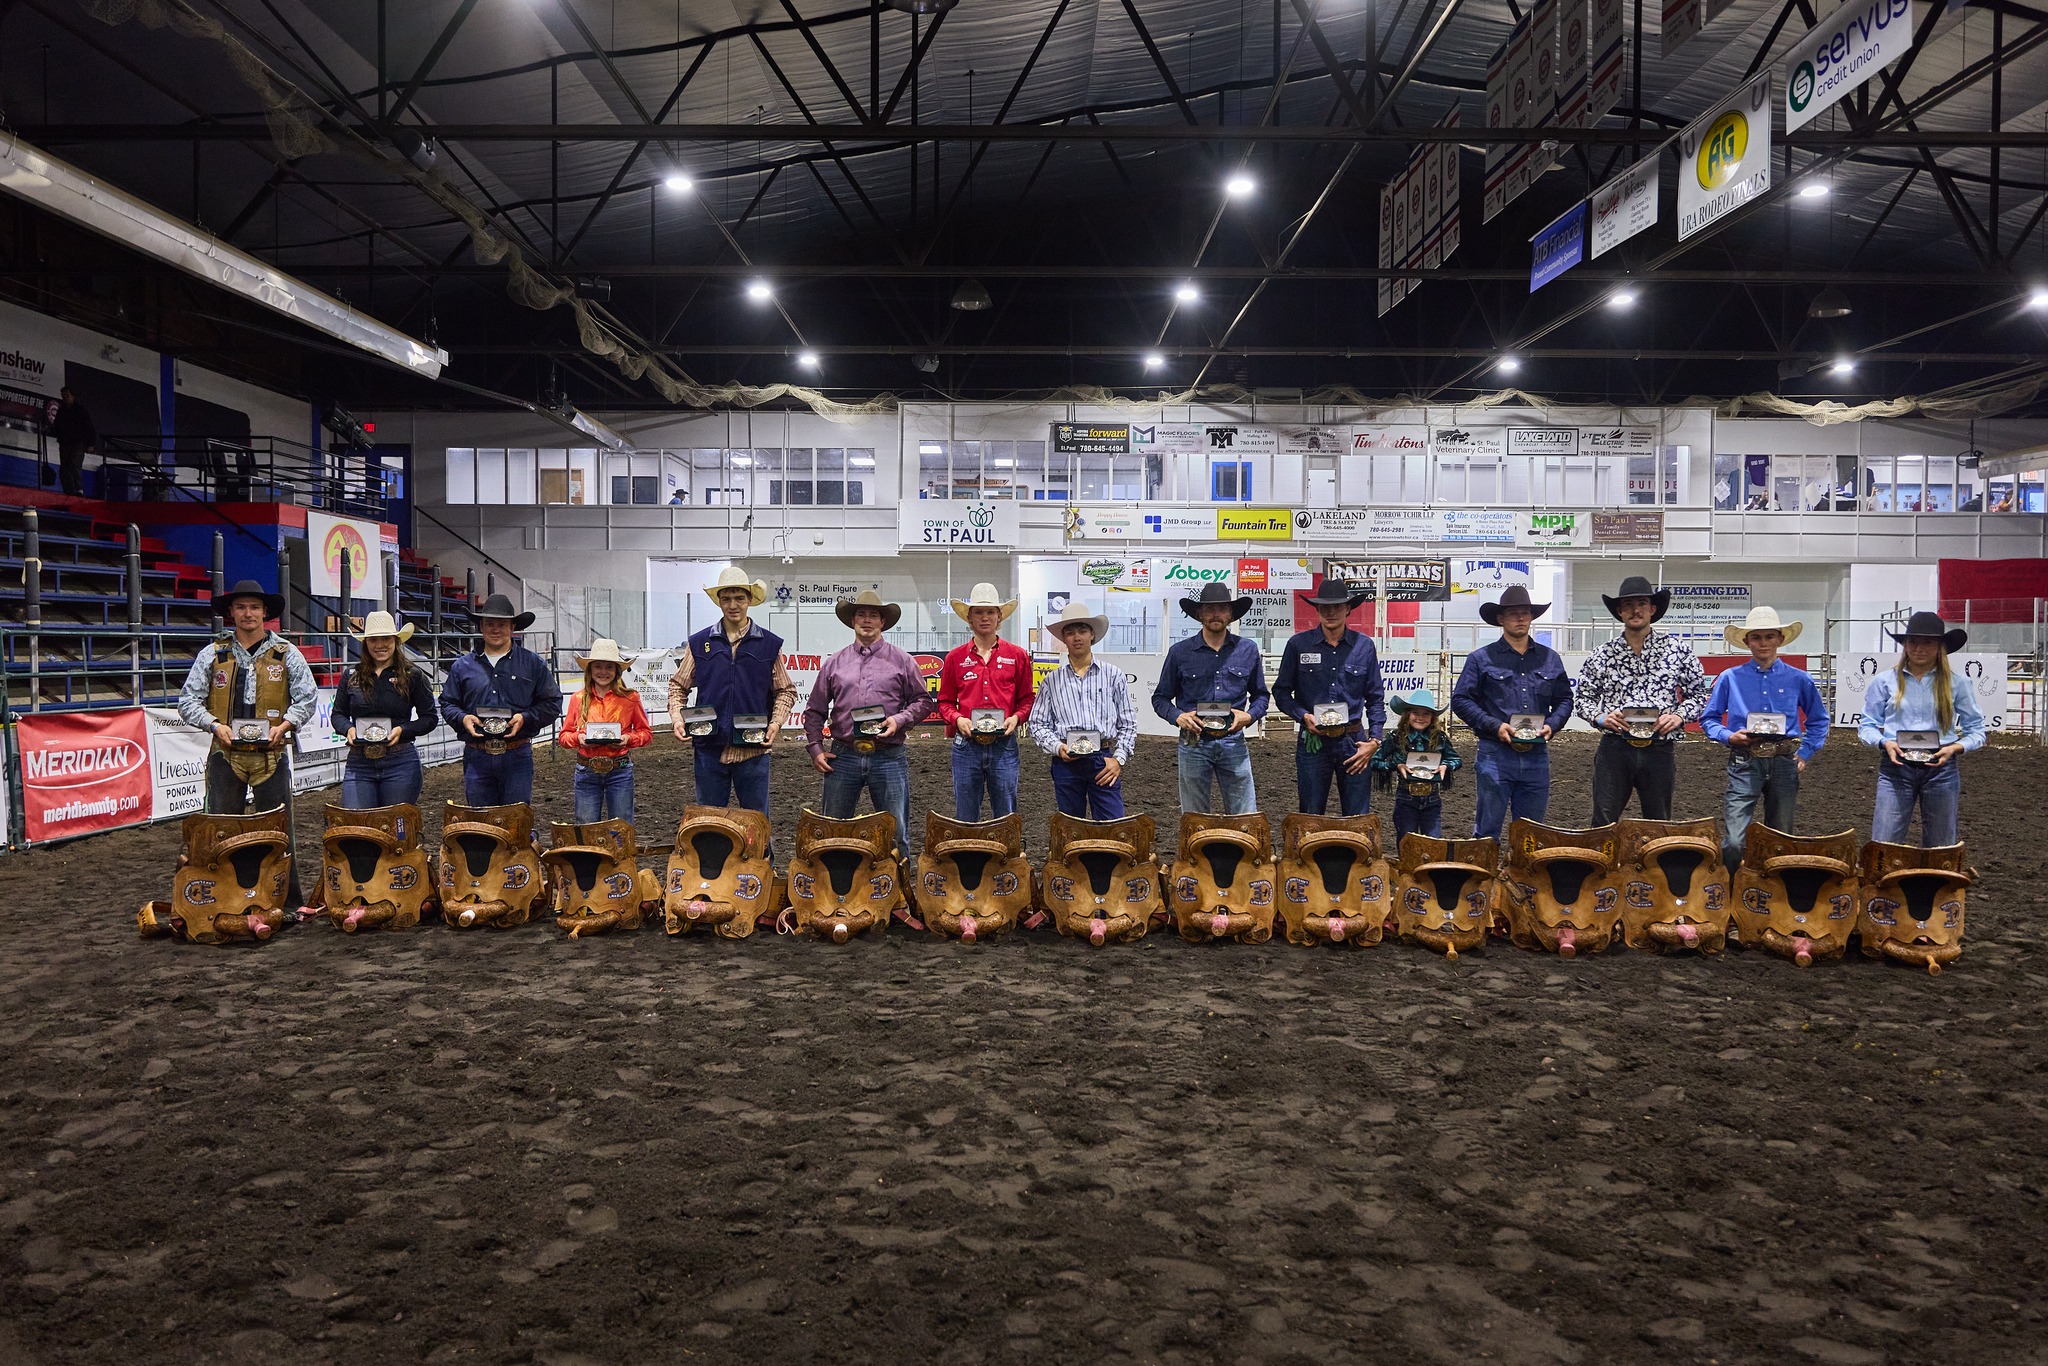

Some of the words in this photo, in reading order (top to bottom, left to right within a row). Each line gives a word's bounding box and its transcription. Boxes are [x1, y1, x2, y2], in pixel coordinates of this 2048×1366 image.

[1816, 0, 1909, 76] servus
[1817, 66, 1847, 97] credit
[1849, 43, 1880, 73] union
[1681, 213, 1697, 235] LRA
[1699, 191, 1729, 225] RODEO
[1731, 169, 1767, 203] FINALS
[1534, 242, 1549, 266] ATB
[1549, 215, 1582, 256] Financial
[1088, 428, 1127, 438] forward
[1515, 432, 1572, 443] LAKELAND
[1354, 433, 1374, 448] Tim
[1435, 446, 1475, 455] Veterinary
[1629, 480, 1677, 489] BUIDE
[1313, 511, 1366, 520] LAKELAND
[1374, 511, 1401, 519] MORROW
[1457, 511, 1469, 519] the
[1470, 512, 1513, 520] co-operators
[1594, 516, 1607, 524] St.
[1610, 516, 1629, 524] Paul
[1221, 518, 1267, 530] Fountain
[1268, 518, 1287, 530] Tire
[1532, 515, 1574, 528] MPH
[923, 528, 946, 543] ST.
[950, 528, 995, 543] PAUL
[1164, 564, 1231, 583] Sobeys
[798, 584, 810, 592] St.
[813, 584, 830, 592] Paul
[833, 584, 858, 594] Figure
[1674, 586, 1725, 596] HEATING
[1726, 586, 1750, 596] LTD.
[799, 596, 833, 605] Skating
[1267, 619, 1290, 627] 6202
[1396, 677, 1424, 691] WASH
[26, 745, 129, 779] MERIDIAN
[166, 785, 197, 798] PONOKA
[43, 795, 139, 823] meridianmfg.com
[169, 797, 202, 812] DAWSON
